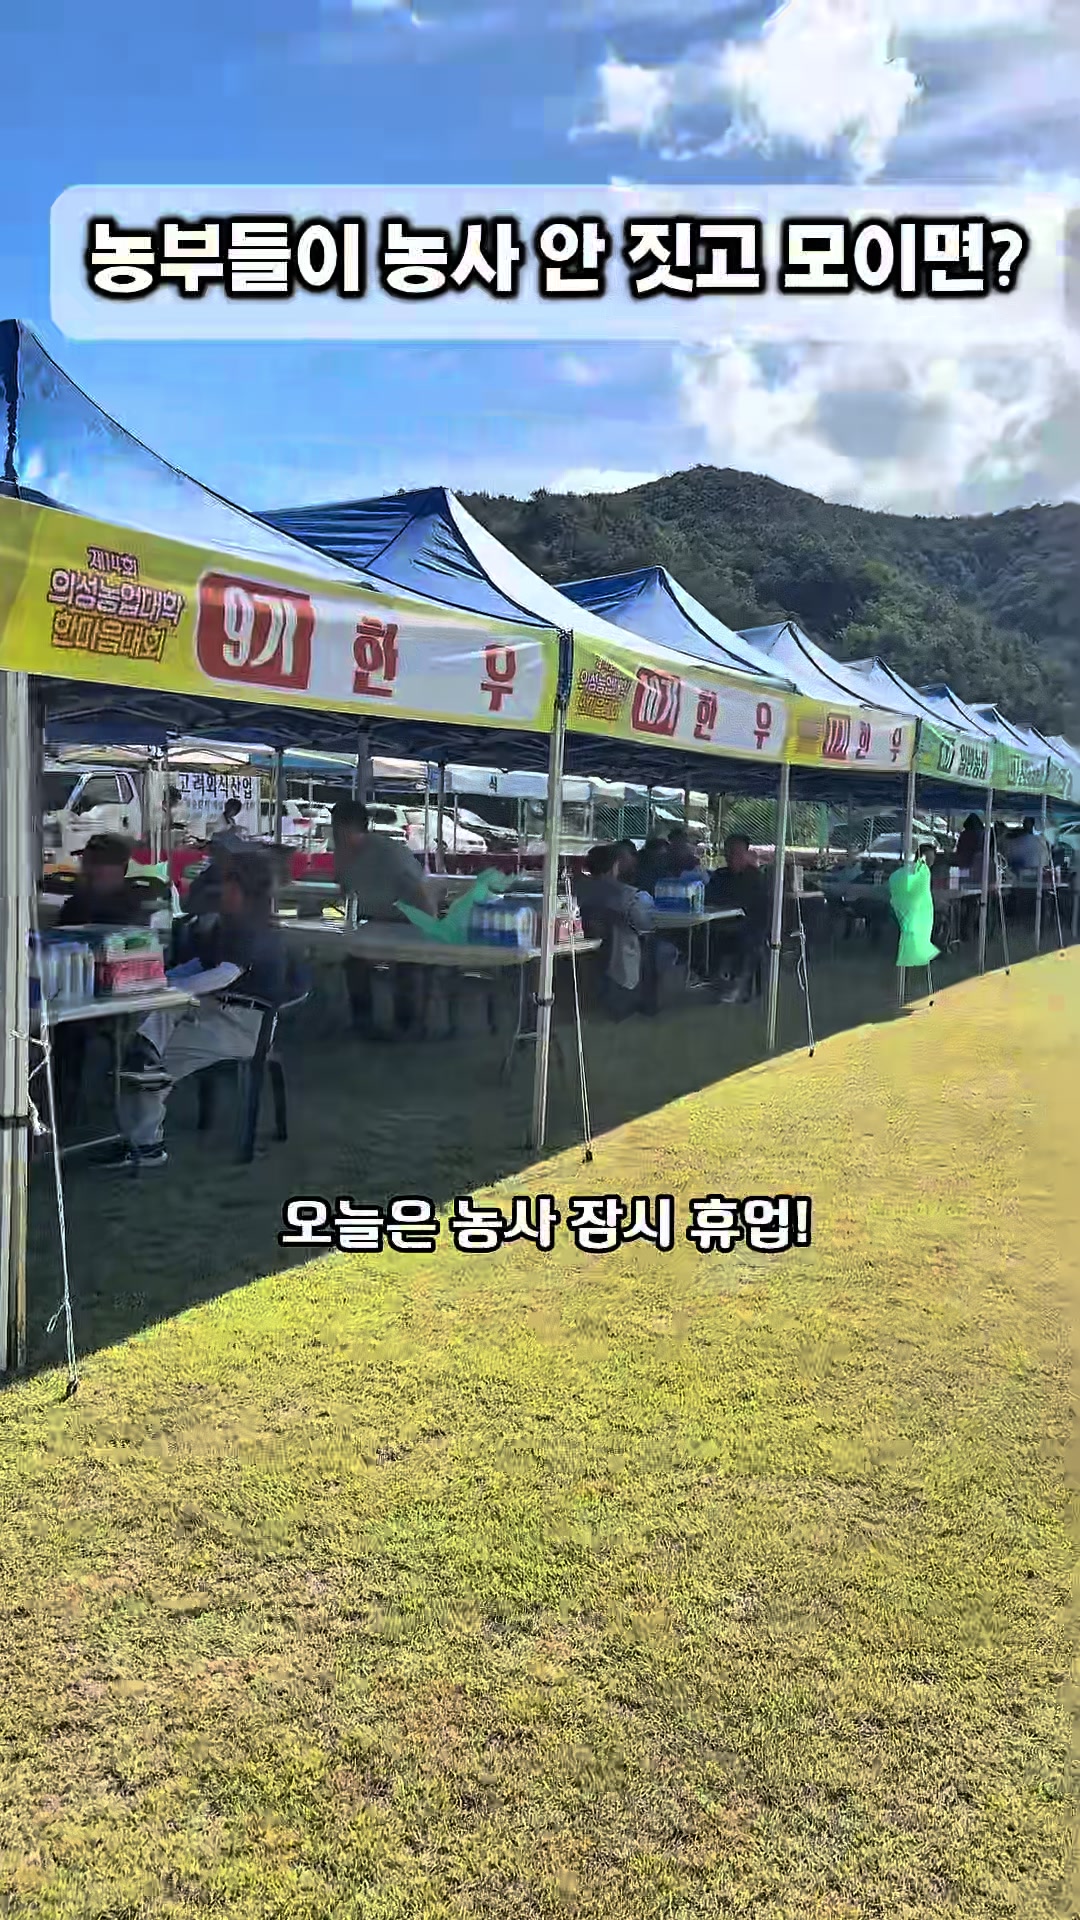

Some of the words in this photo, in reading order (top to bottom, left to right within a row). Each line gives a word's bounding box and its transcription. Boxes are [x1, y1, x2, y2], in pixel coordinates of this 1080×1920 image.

[87, 546, 138, 578] 제14회
[47, 568, 184, 626] 의성농업대학
[52, 610, 167, 663] 한마음대회
[222, 586, 298, 676] 9기
[179, 772, 252, 799] 고려외식산업
